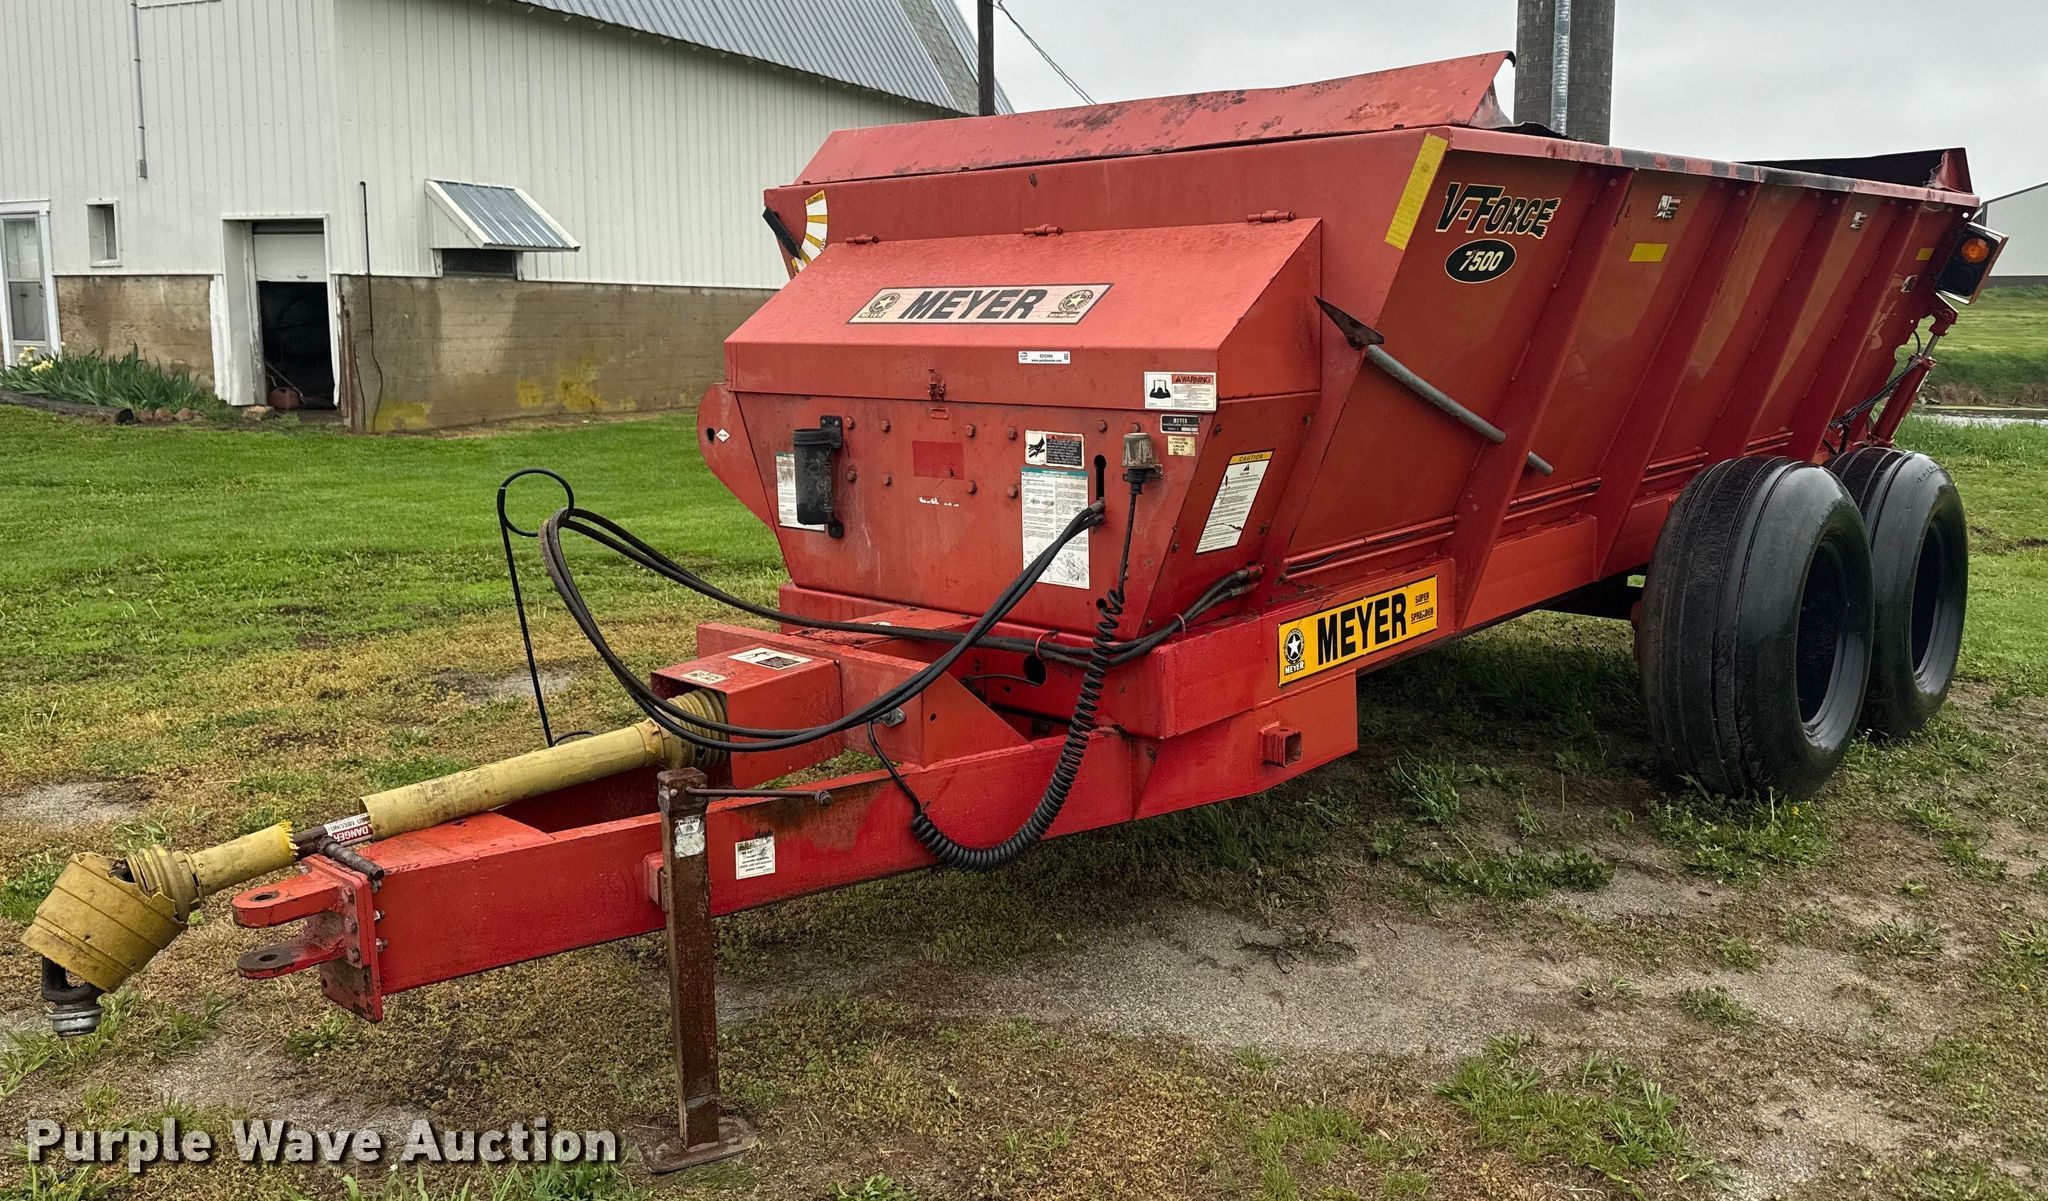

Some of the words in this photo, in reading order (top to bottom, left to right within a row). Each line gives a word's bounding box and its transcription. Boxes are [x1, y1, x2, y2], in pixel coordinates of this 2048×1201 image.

[1458, 250, 1504, 271] 7500
[898, 289, 1048, 319] MEYER
[1181, 375, 1211, 384] WARNING
[1238, 453, 1264, 462] CAUTION
[1414, 592, 1430, 604] SUPER
[1317, 592, 1407, 666] MEYER
[1284, 660, 1305, 675] MEYER
